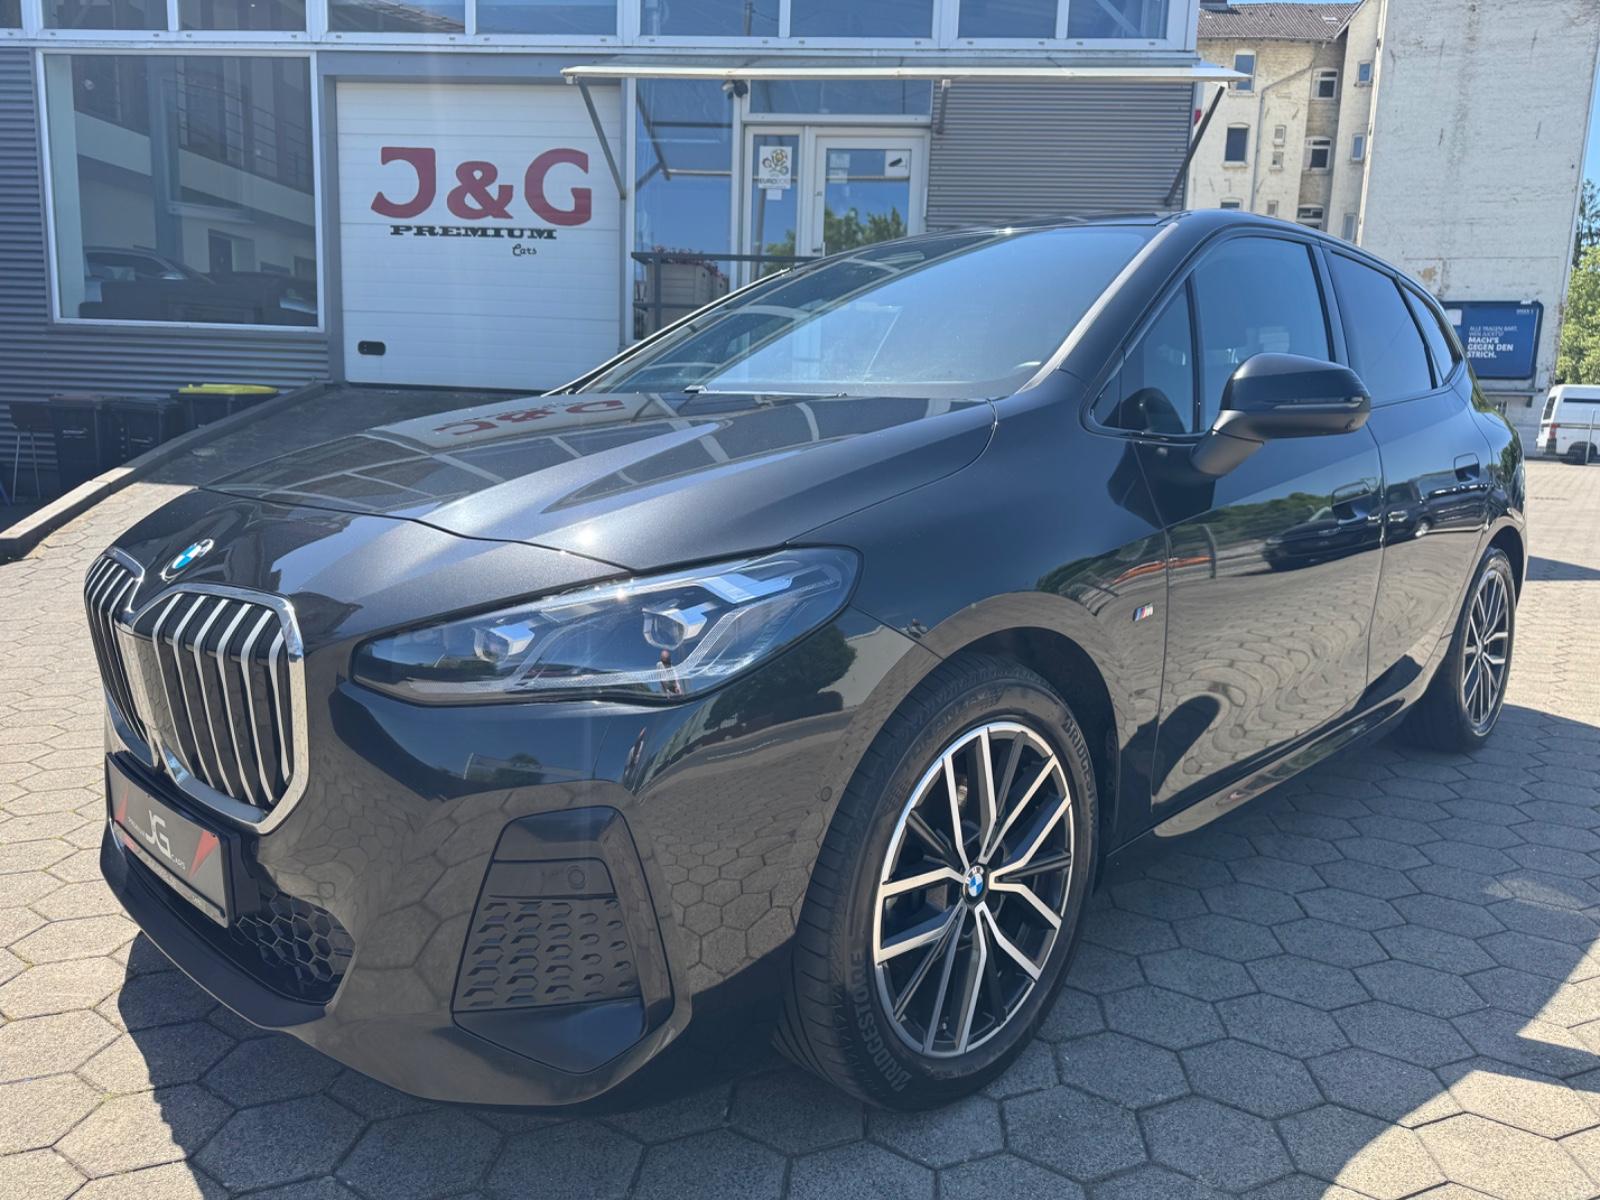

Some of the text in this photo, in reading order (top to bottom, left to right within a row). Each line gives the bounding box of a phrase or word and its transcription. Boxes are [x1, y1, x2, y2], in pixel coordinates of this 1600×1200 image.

[370, 146, 592, 226] J&G
[390, 225, 557, 240] PREMIUM
[512, 243, 537, 257] Cars
[1467, 343, 1514, 352] GEGEN DEN
[1466, 351, 1497, 359] STRICH.
[850, 950, 913, 1092] BRIDGESTONE
